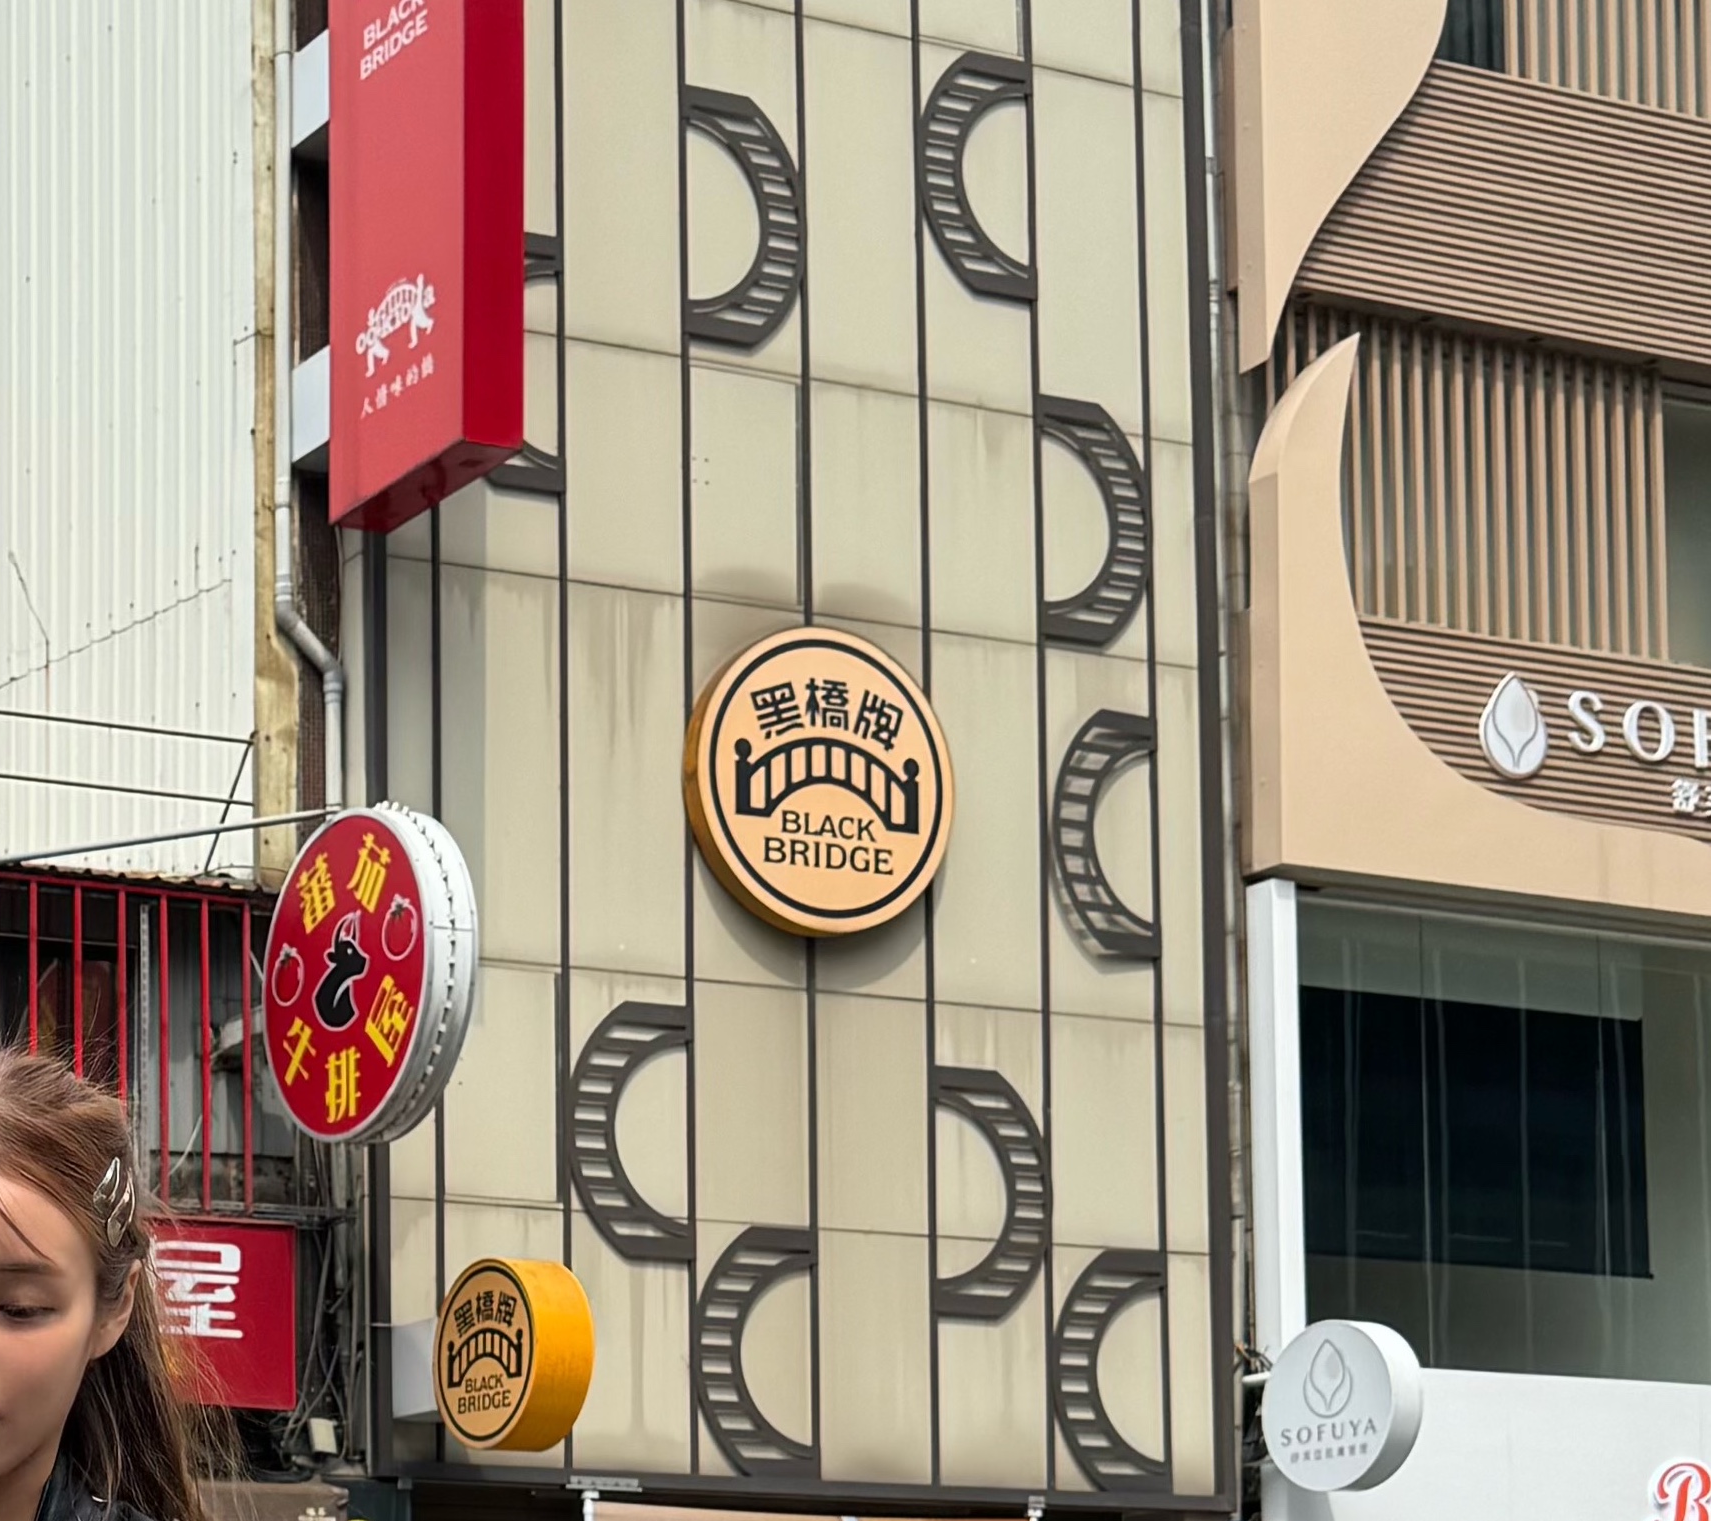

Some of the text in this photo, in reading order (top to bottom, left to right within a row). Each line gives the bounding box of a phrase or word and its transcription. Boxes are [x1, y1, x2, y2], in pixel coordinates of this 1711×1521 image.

[360, 8, 428, 80] BRIDGE
[750, 677, 903, 751] 黑橋牌
[781, 809, 877, 843] BLACK
[763, 836, 894, 876] BRIDGE
[295, 832, 392, 935] 蕃茄
[453, 1290, 517, 1338] 黑橋牌
[457, 1389, 512, 1415] BRIDGE
[464, 1373, 504, 1394] BLACK
[1280, 1417, 1377, 1447] SOFUYA
